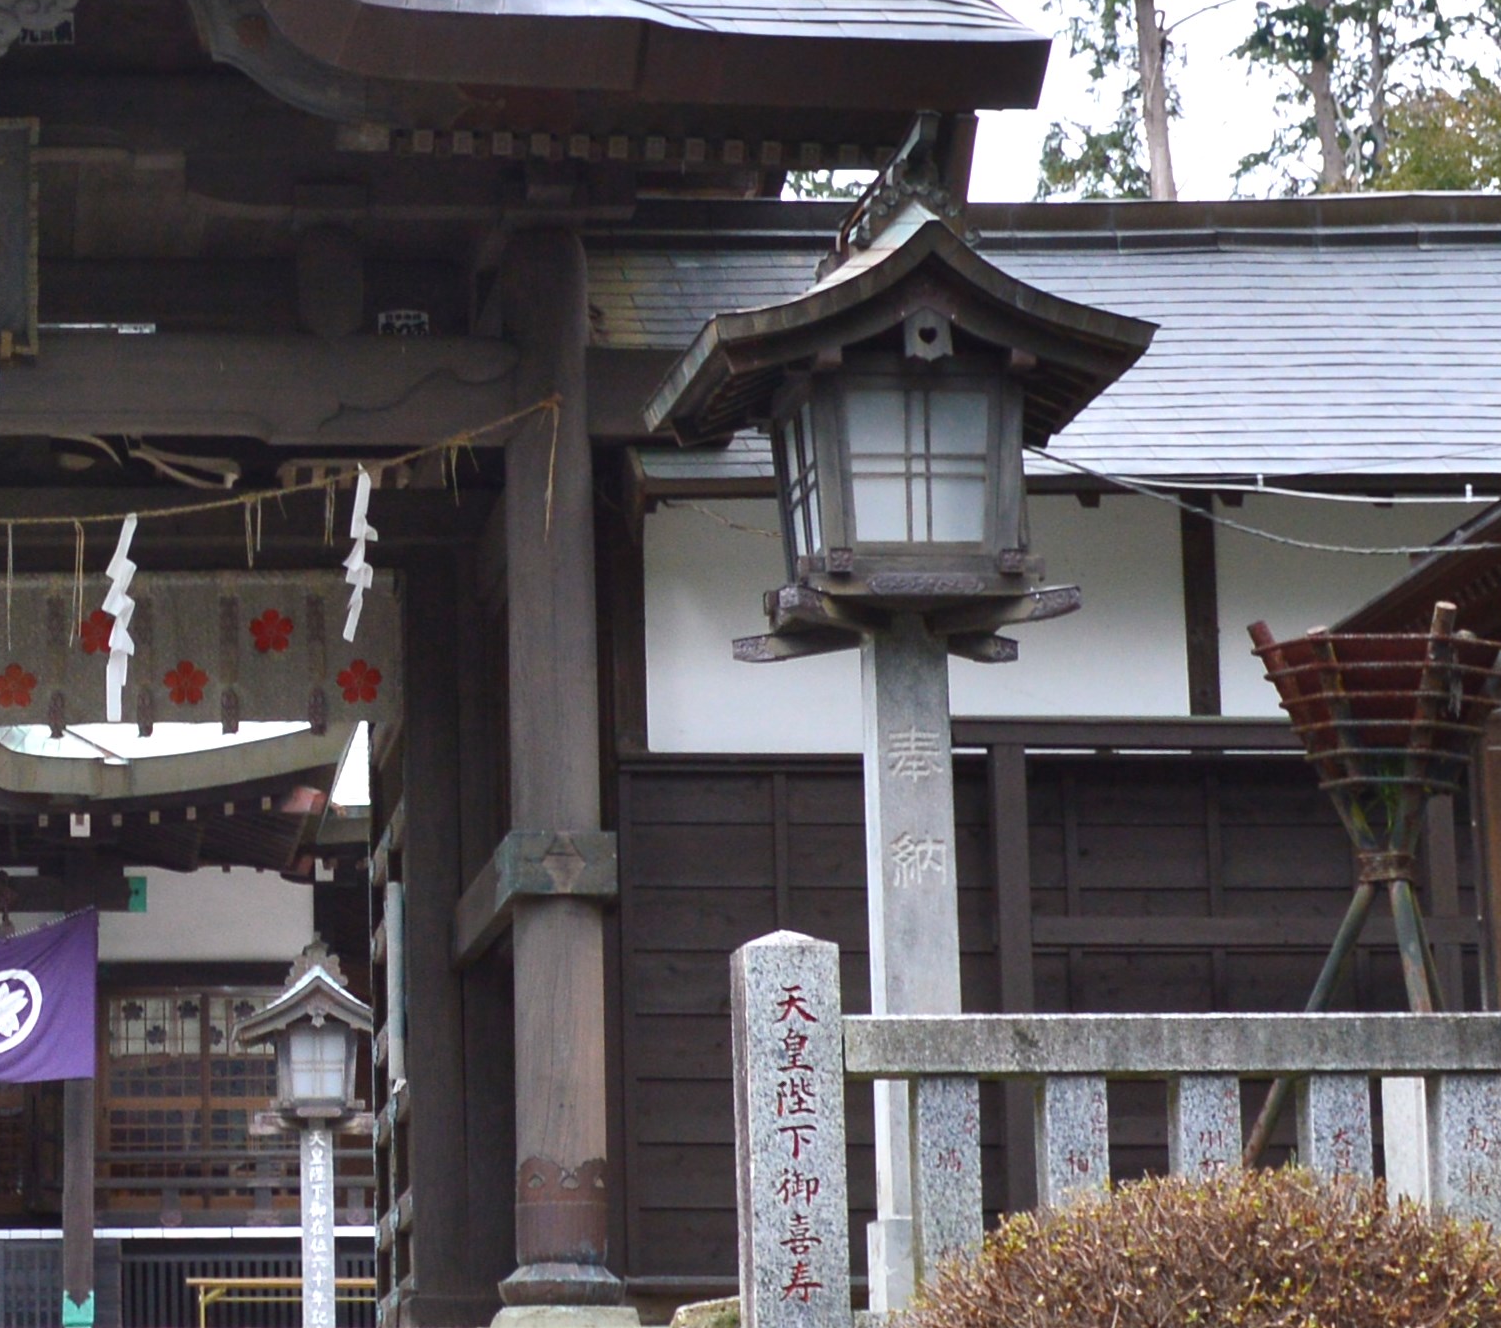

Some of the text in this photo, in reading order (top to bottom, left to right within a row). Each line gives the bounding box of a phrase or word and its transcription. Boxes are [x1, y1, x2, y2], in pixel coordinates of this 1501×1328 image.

[887, 725, 947, 888] 奉納
[774, 984, 822, 1304] 天皇陛下御喜寿
